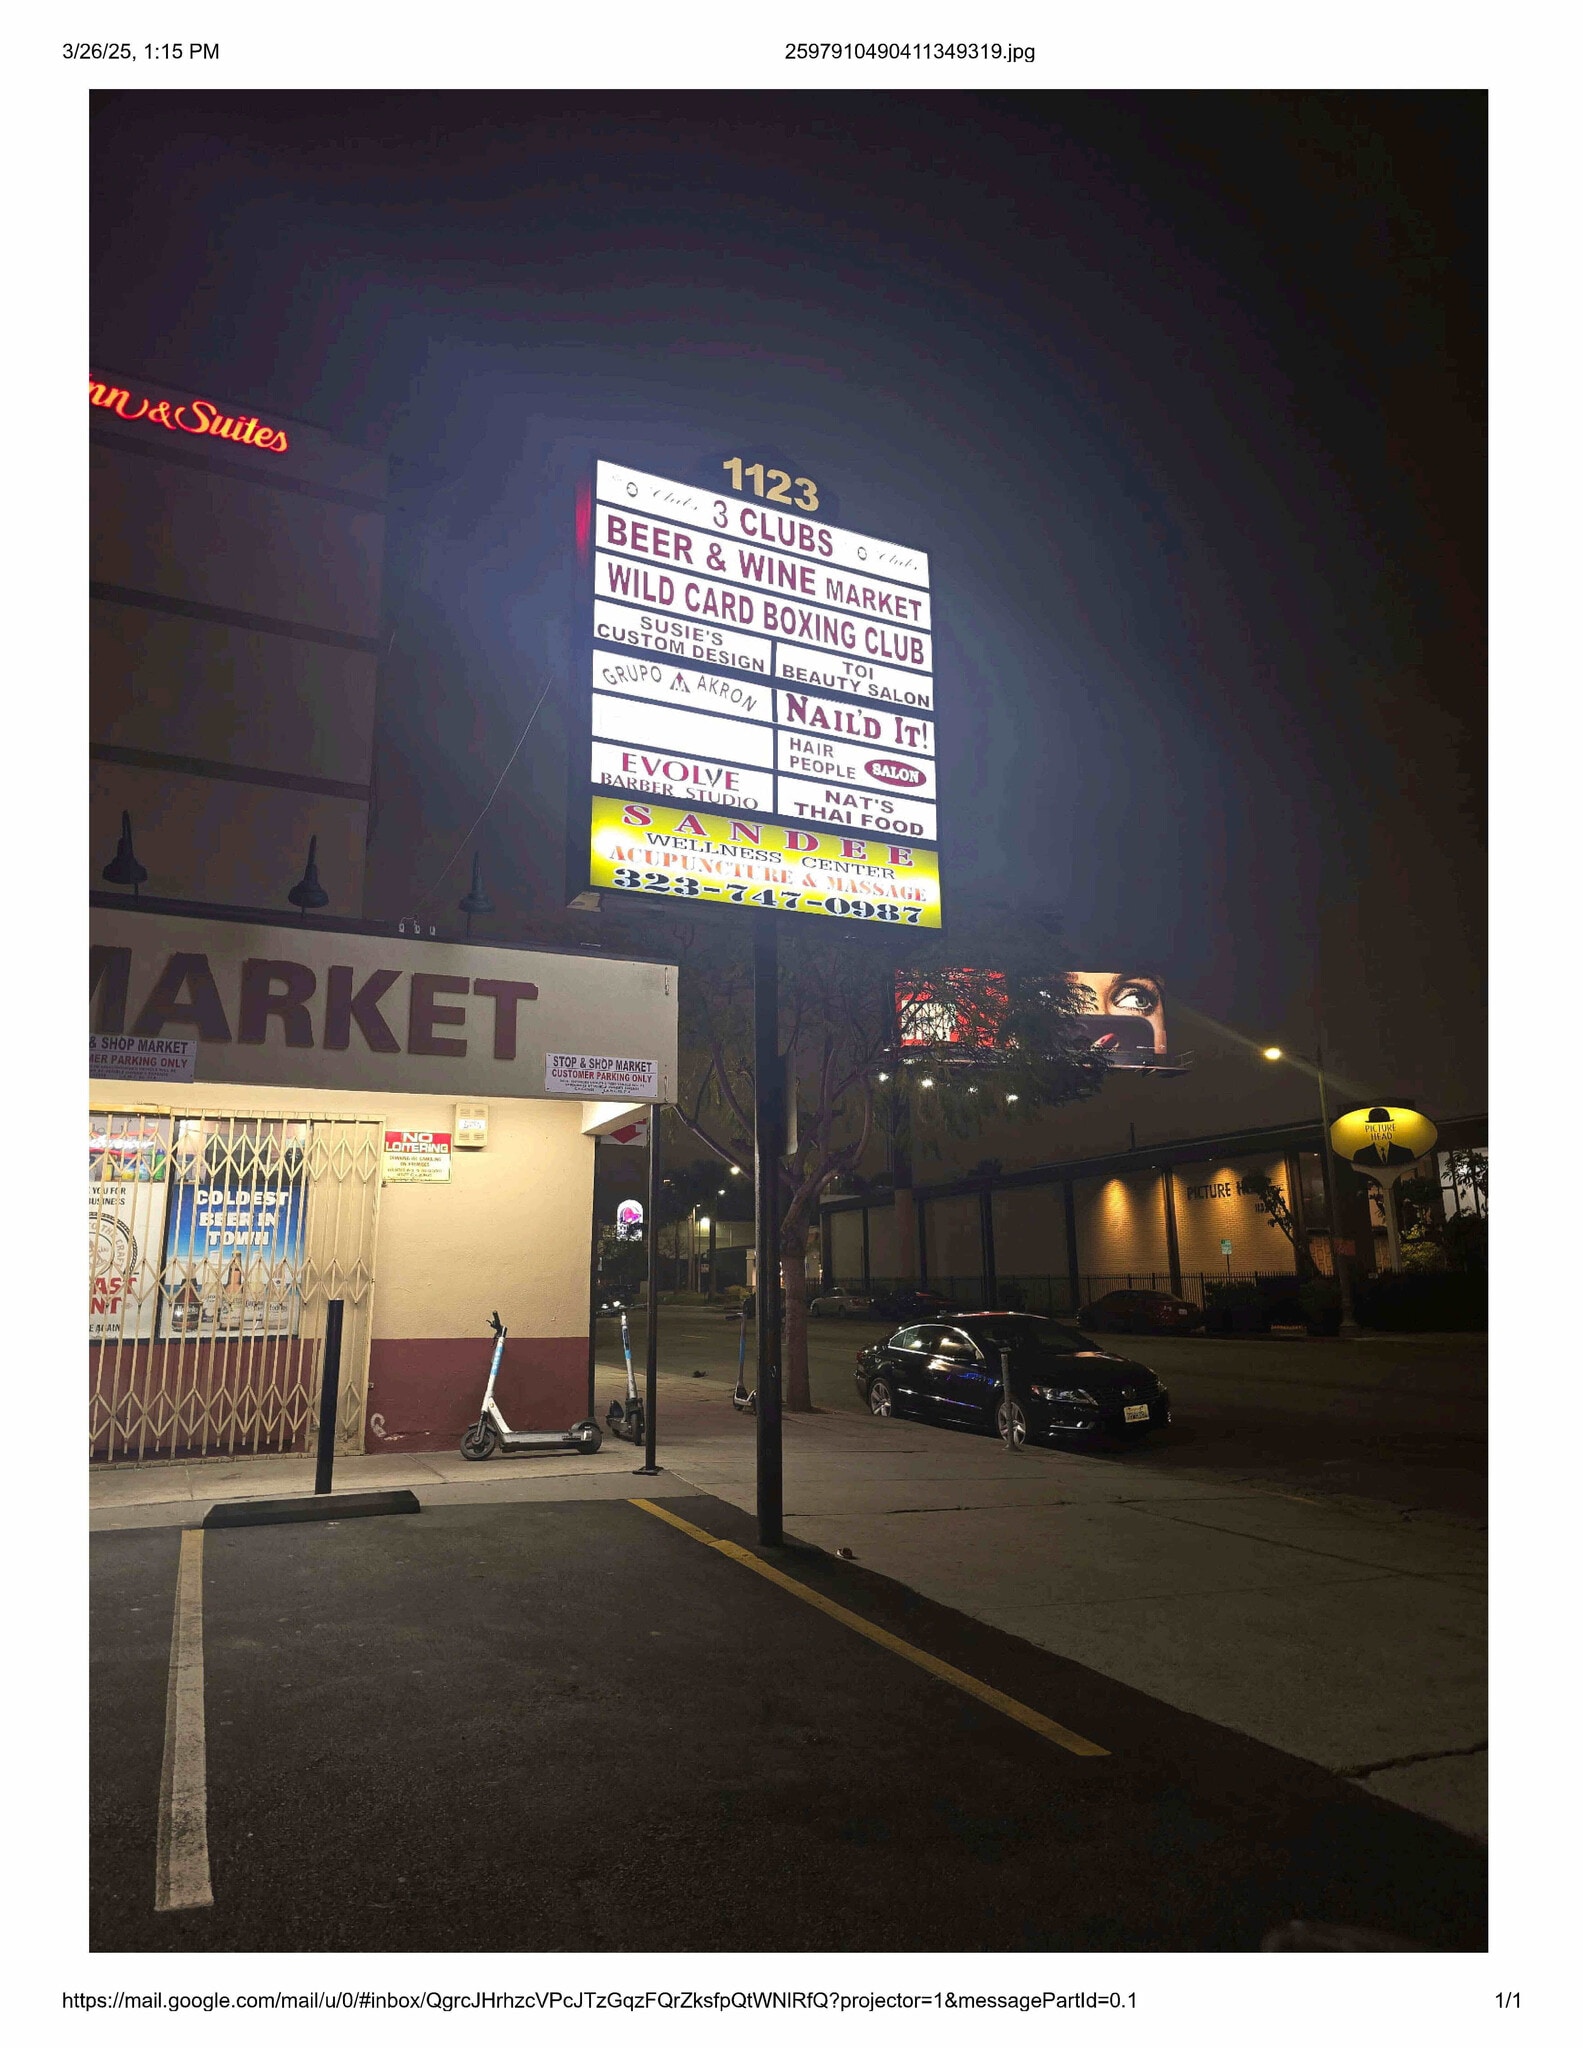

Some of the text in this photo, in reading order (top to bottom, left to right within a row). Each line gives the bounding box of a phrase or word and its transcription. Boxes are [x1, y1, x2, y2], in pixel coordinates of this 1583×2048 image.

[89, 380, 288, 452] nn & Suites
[723, 457, 820, 512] 1123
[713, 499, 834, 558] 3 CLUBS
[607, 514, 923, 622] BEER & WINE MARKET
[607, 561, 925, 666] WILD CARD BOXING CLUB
[640, 616, 725, 647] SUSIE'S
[597, 622, 766, 673] CUSTOM DESIGN
[842, 661, 875, 680] TOI
[602, 665, 758, 712] GRUPO AKRON
[782, 664, 931, 708] BEAUTY SALON
[789, 737, 835, 758] HAIR
[621, 752, 741, 793] EVOLVE
[789, 755, 921, 784] PEOPLE SALON
[600, 771, 760, 811] BARBER STUDIO
[824, 789, 896, 814] NAT'S
[794, 801, 925, 837] THAI FOOD
[622, 804, 915, 867] SANDEE
[646, 832, 896, 880] WELLNESS CENTER
[609, 845, 927, 903] ACUPUNCTURE & MASSAGE
[613, 868, 924, 925] 323-747-0987
[101, 1037, 135, 1051] SHOP
[137, 1039, 188, 1054] MARKET
[111, 1055, 157, 1067] PARKING
[160, 1057, 188, 1068] ONLY
[551, 1068, 652, 1083] CUSTOMER PARKING ONLY
[552, 1055, 652, 1072] STOP & SHOP MARKET
[402, 1132, 434, 1144] NO
[1364, 1124, 1396, 1133] PICTURE
[385, 1141, 449, 1154] LOITERING
[89, 1197, 126, 1206] USINES
[196, 1190, 289, 1206] COLDEST
[1186, 1183, 1231, 1201] PICTURE
[199, 1212, 277, 1227] BEER IN
[209, 1231, 270, 1246] TOWN
